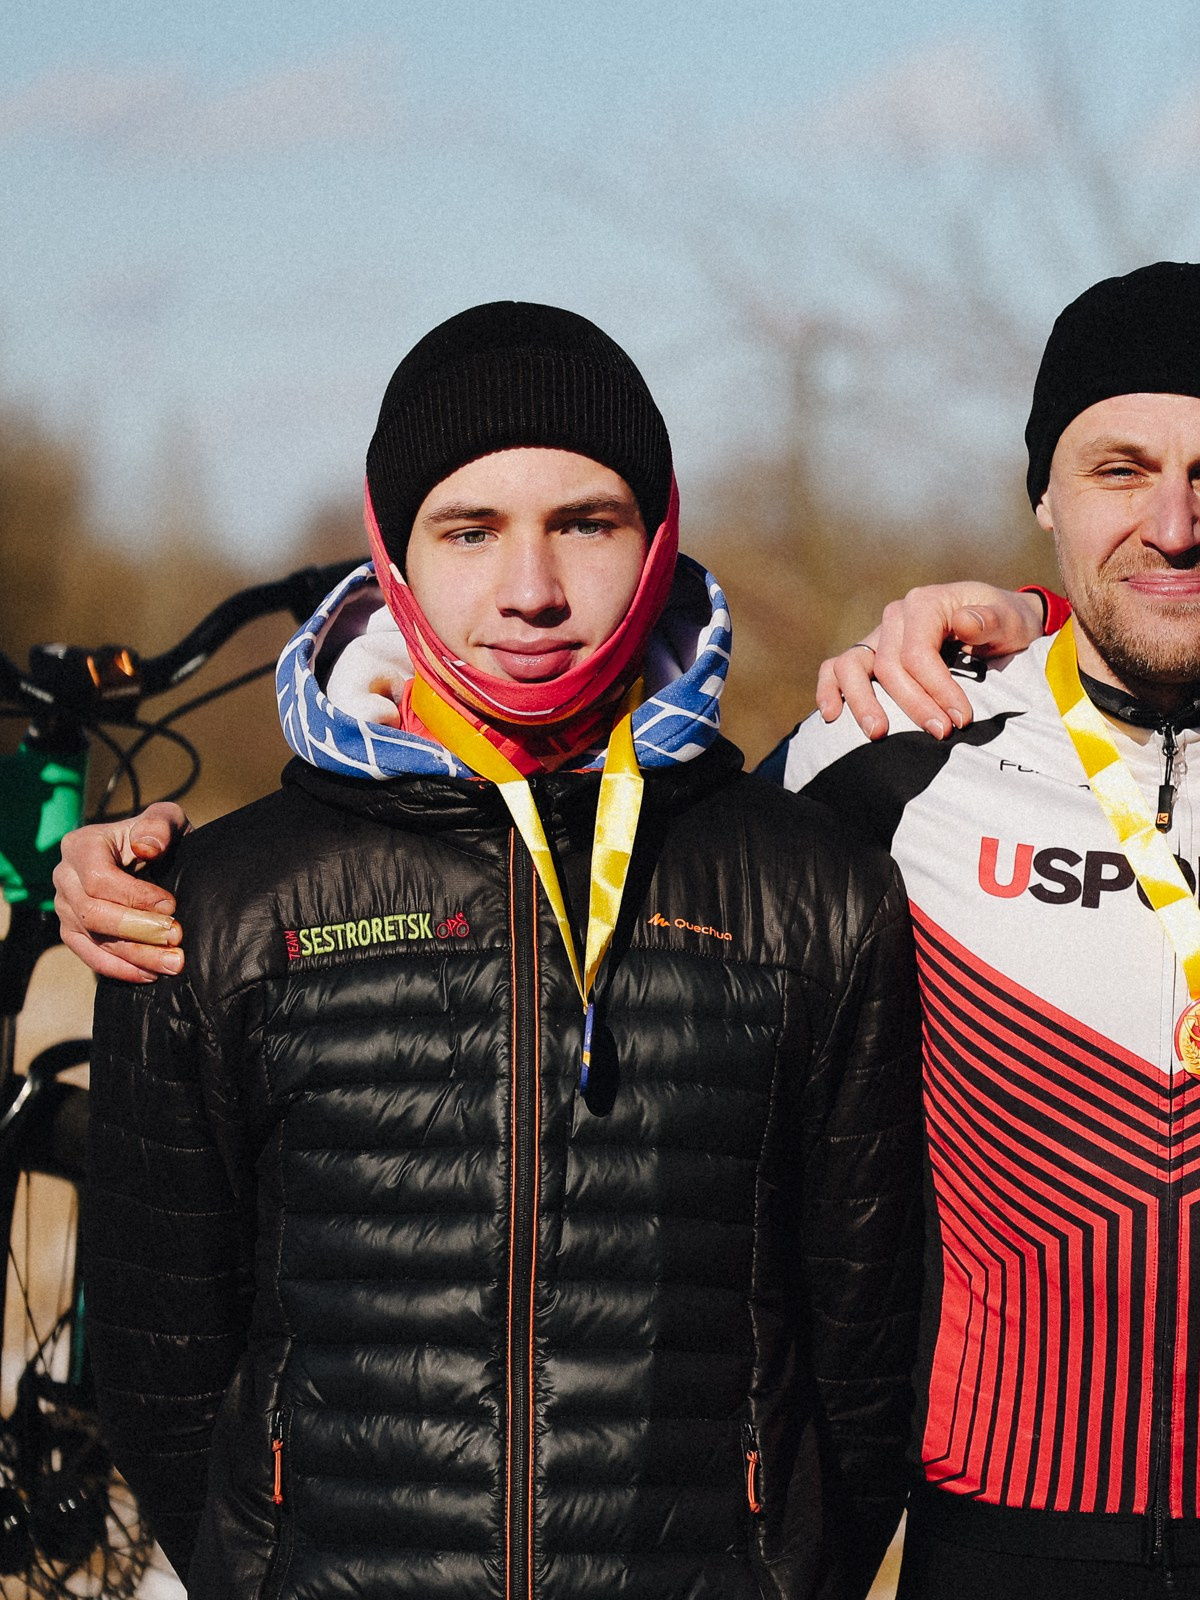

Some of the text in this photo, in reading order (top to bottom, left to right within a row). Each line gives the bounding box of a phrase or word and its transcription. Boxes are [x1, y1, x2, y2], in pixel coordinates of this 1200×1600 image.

[299, 912, 434, 957] SESTRORETSK
[674, 918, 733, 941] Quechua
[284, 930, 301, 961] TEAM
